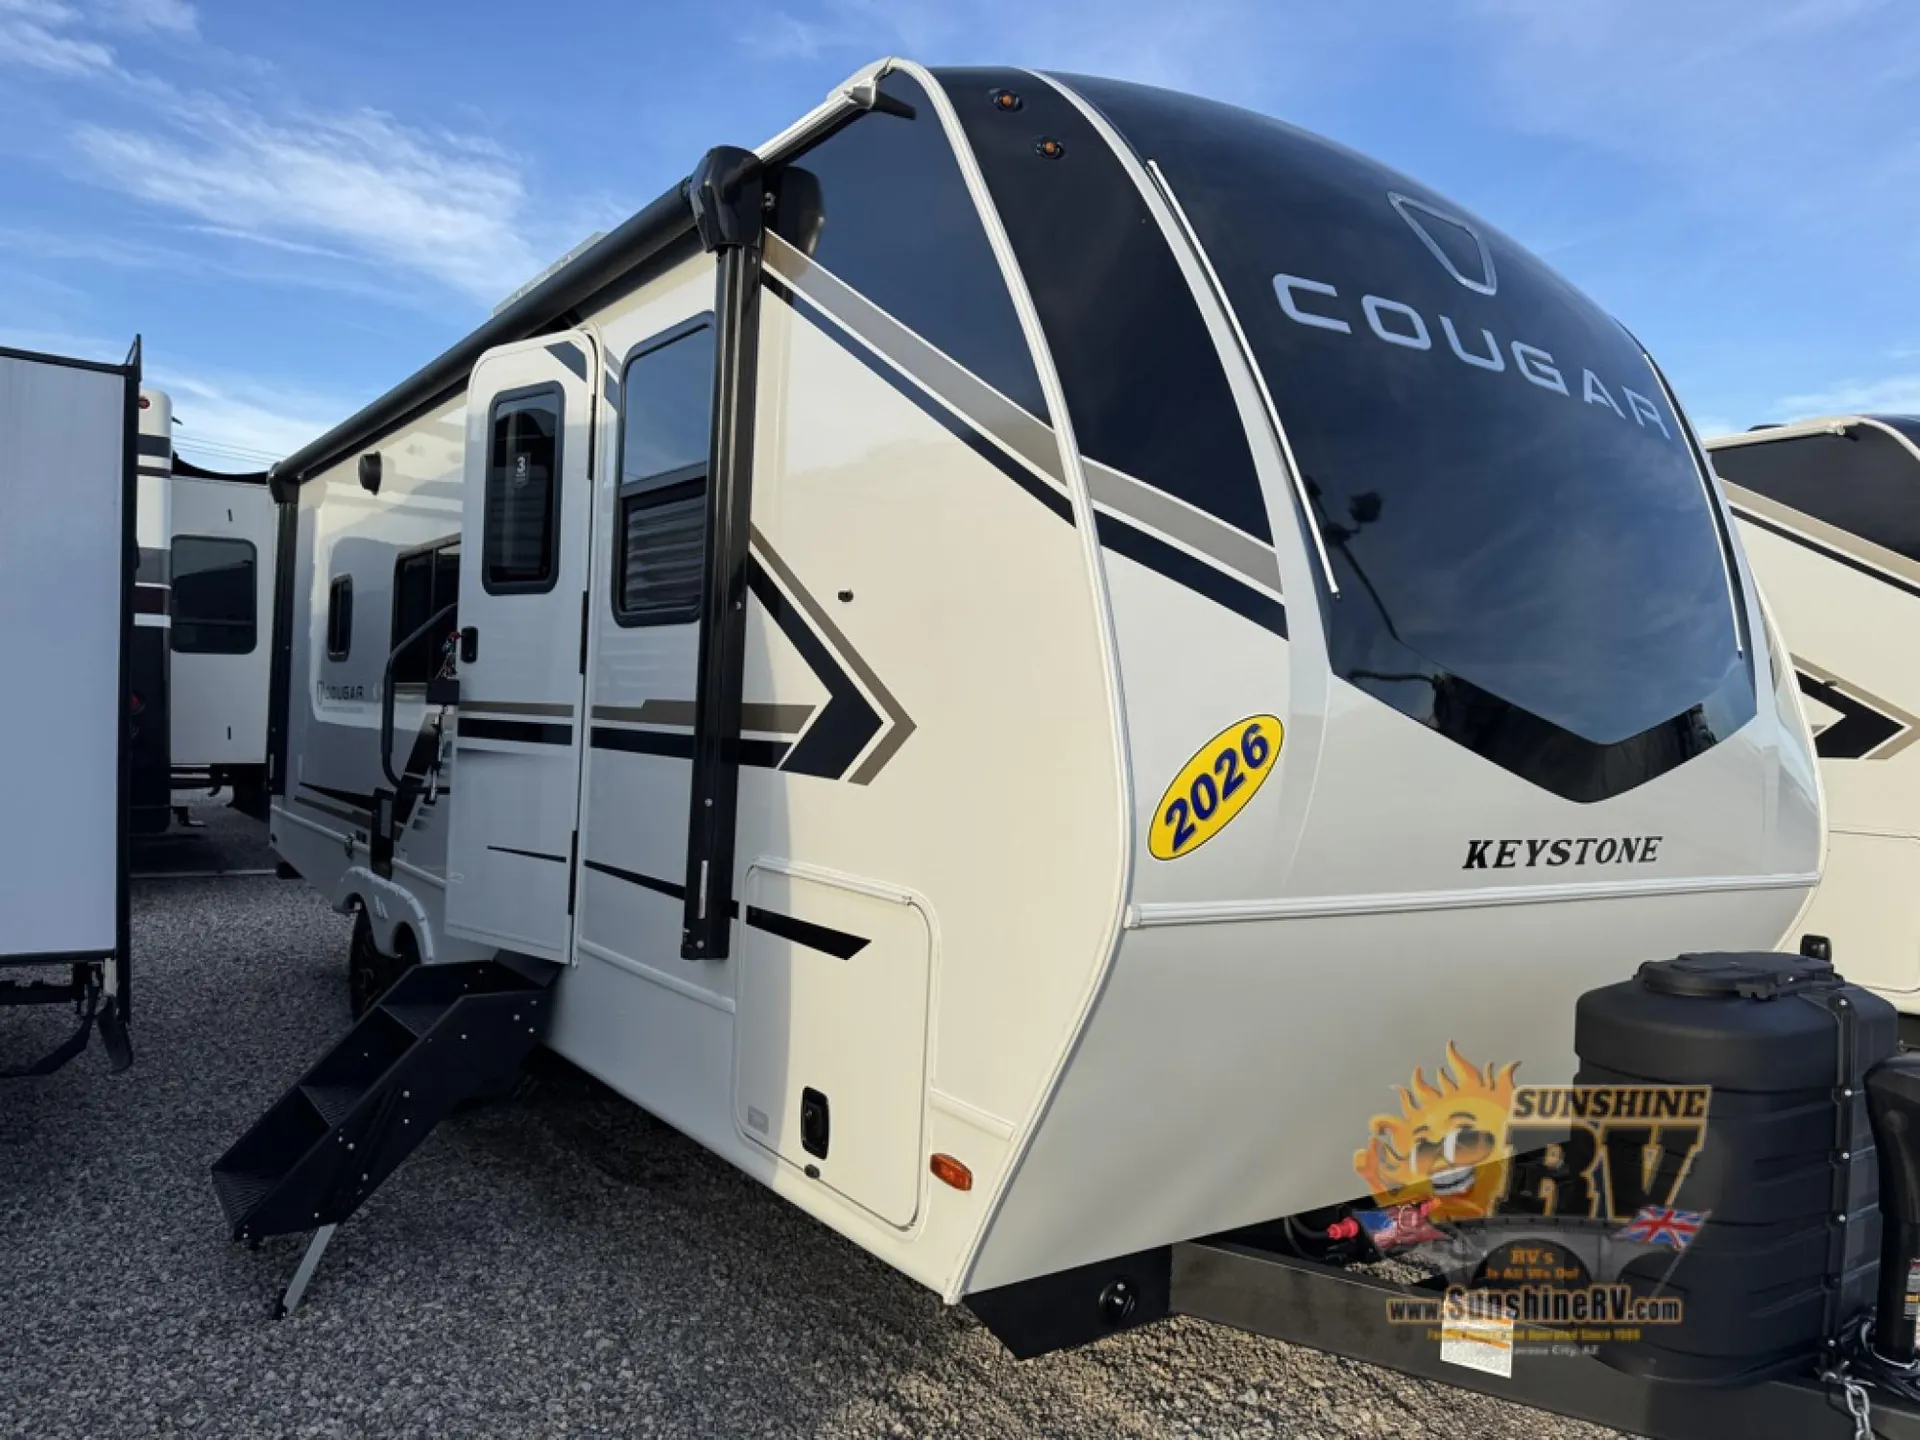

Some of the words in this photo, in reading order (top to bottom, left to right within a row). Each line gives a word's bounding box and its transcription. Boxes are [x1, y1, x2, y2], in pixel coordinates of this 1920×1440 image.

[1272, 273, 1671, 440] COUGAR
[1164, 723, 1269, 852] 2026
[1462, 836, 1664, 869] KEYSTONE
